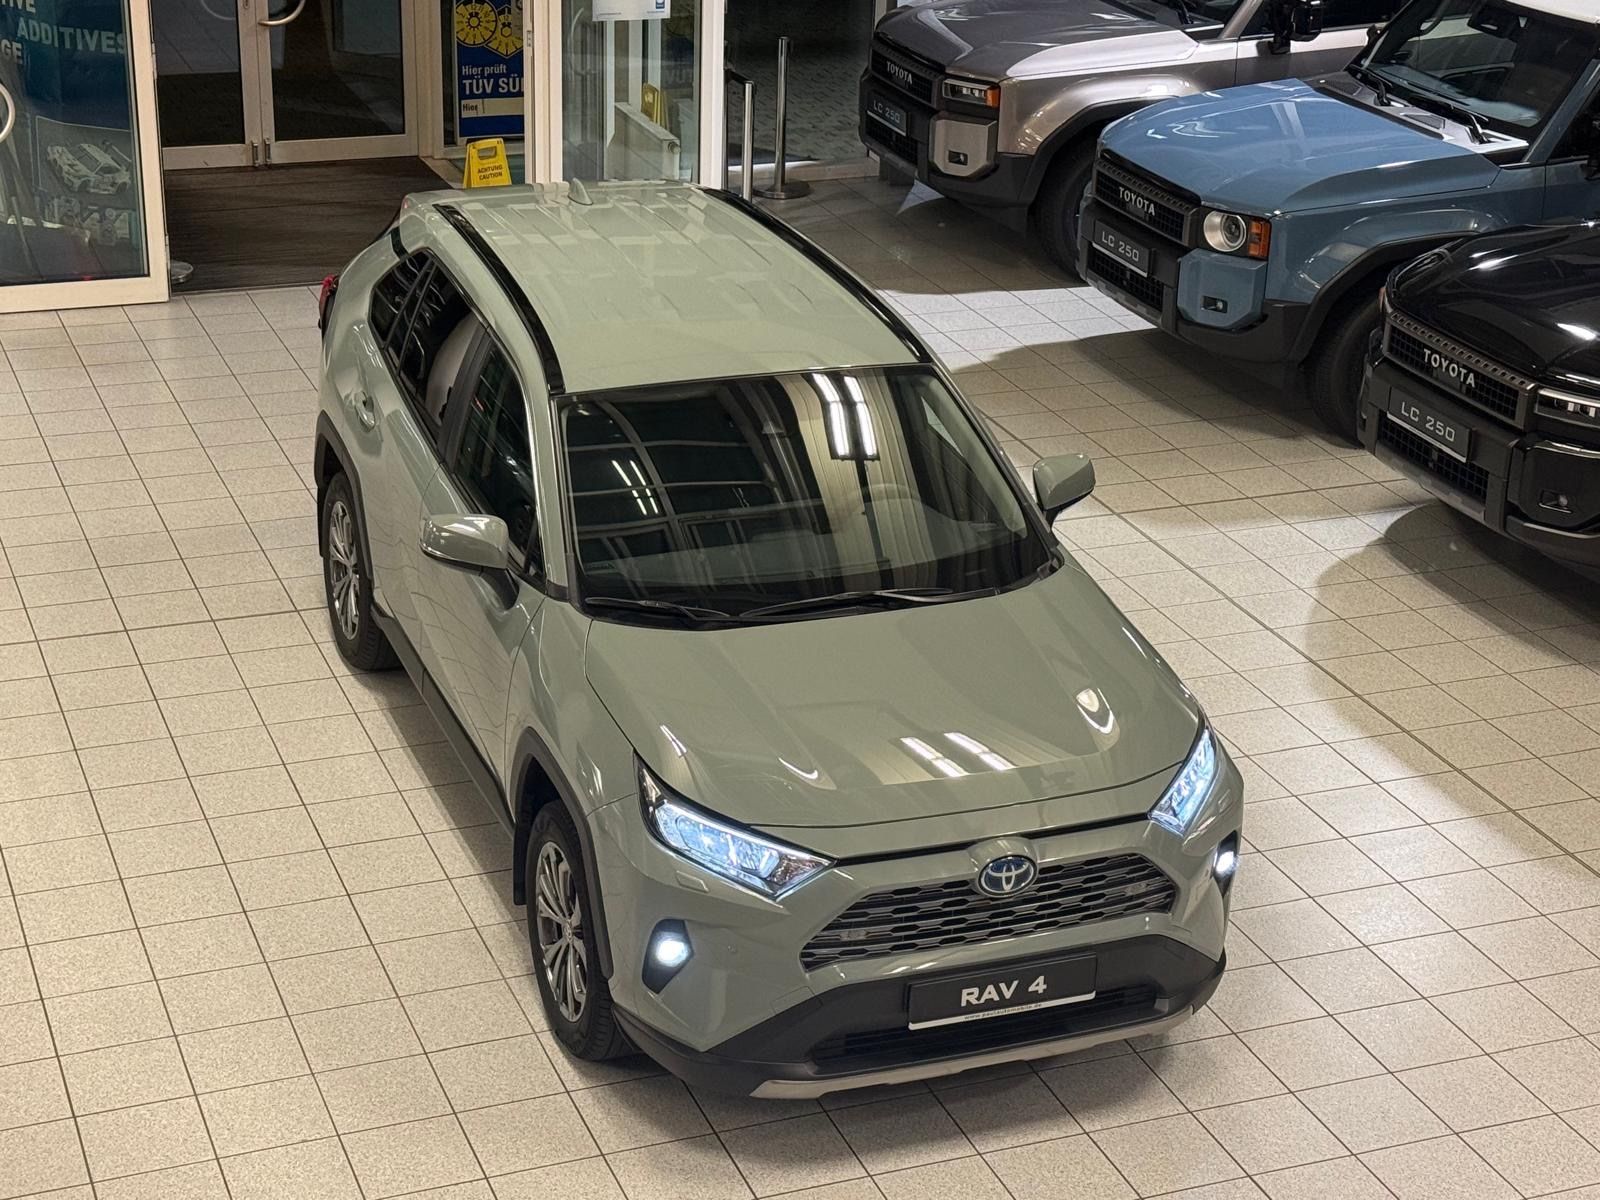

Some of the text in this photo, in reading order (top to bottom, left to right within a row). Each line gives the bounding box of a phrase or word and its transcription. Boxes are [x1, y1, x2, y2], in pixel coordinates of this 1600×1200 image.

[17, 17, 125, 54] ADDITIVES
[462, 63, 507, 77] Hier prüft
[886, 61, 913, 85] TOYOTA
[462, 75, 494, 95] TÜV
[885, 107, 901, 124] 250
[478, 164, 503, 174] ACHTUNG
[479, 171, 503, 180] CAUTION
[1119, 186, 1156, 216] TOYOTA
[1102, 231, 1140, 262] LC 250
[1423, 348, 1476, 388] TOYOTA
[1401, 401, 1456, 442] LC 250
[960, 975, 1047, 1007] RAV 4
